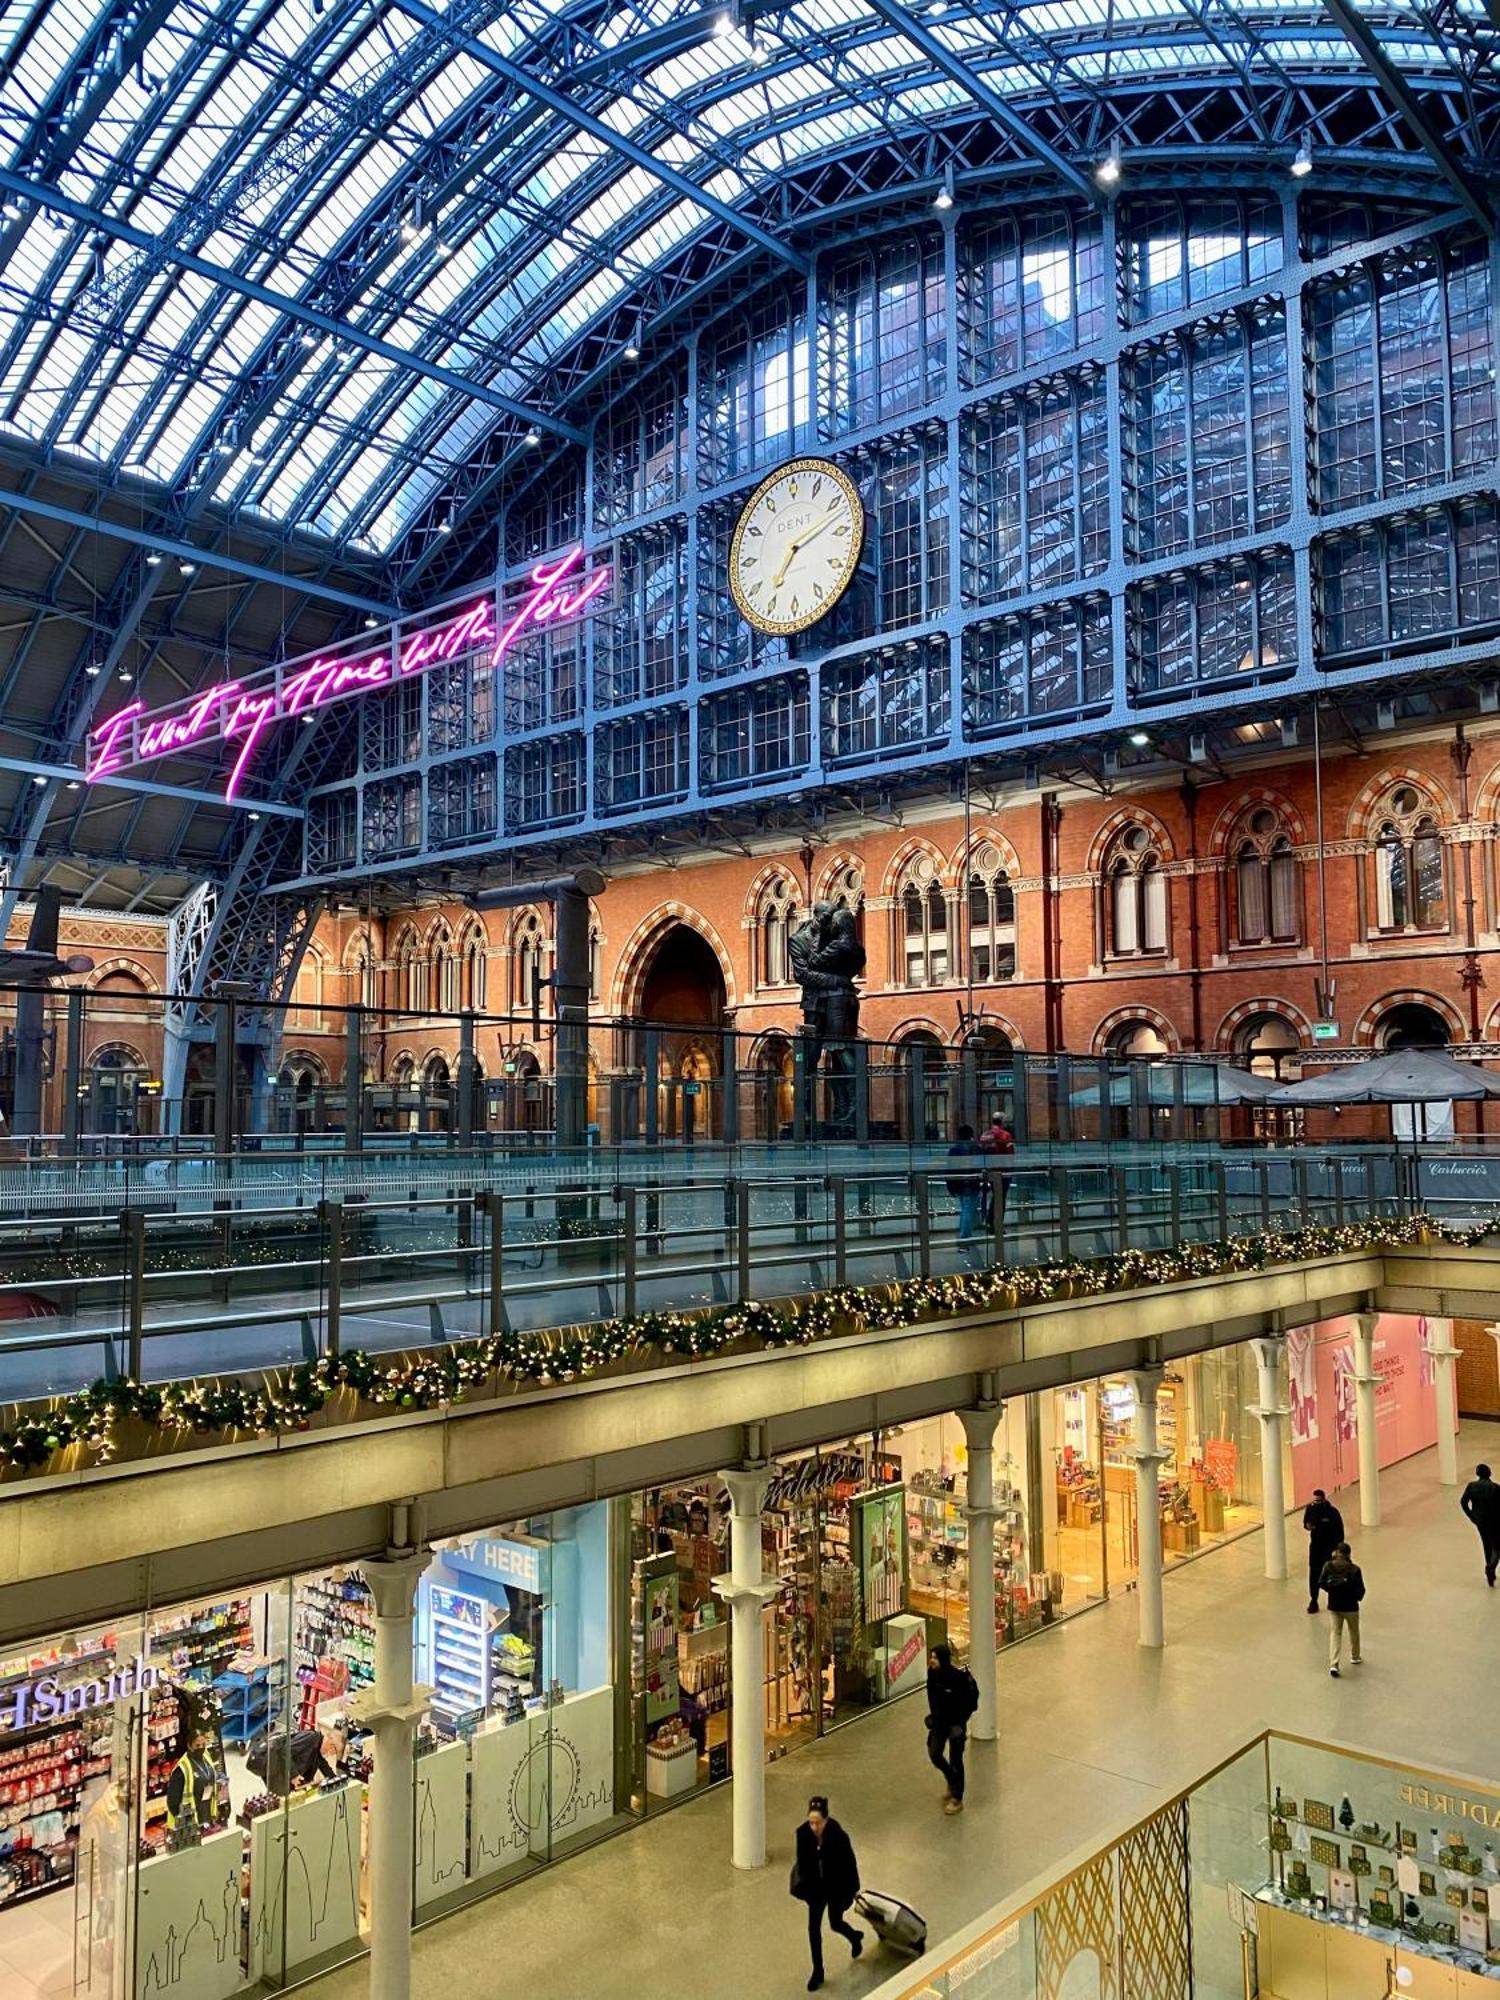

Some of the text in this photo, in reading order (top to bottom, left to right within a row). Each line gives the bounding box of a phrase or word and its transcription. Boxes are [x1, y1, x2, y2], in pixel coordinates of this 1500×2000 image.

[777, 513, 812, 533] DENT
[84, 701, 143, 784] I
[223, 695, 275, 804] my
[401, 600, 496, 672] with
[491, 546, 608, 667] You
[1427, 1162, 1488, 1176] Carluccio's
[445, 1541, 536, 1579] AY HERE
